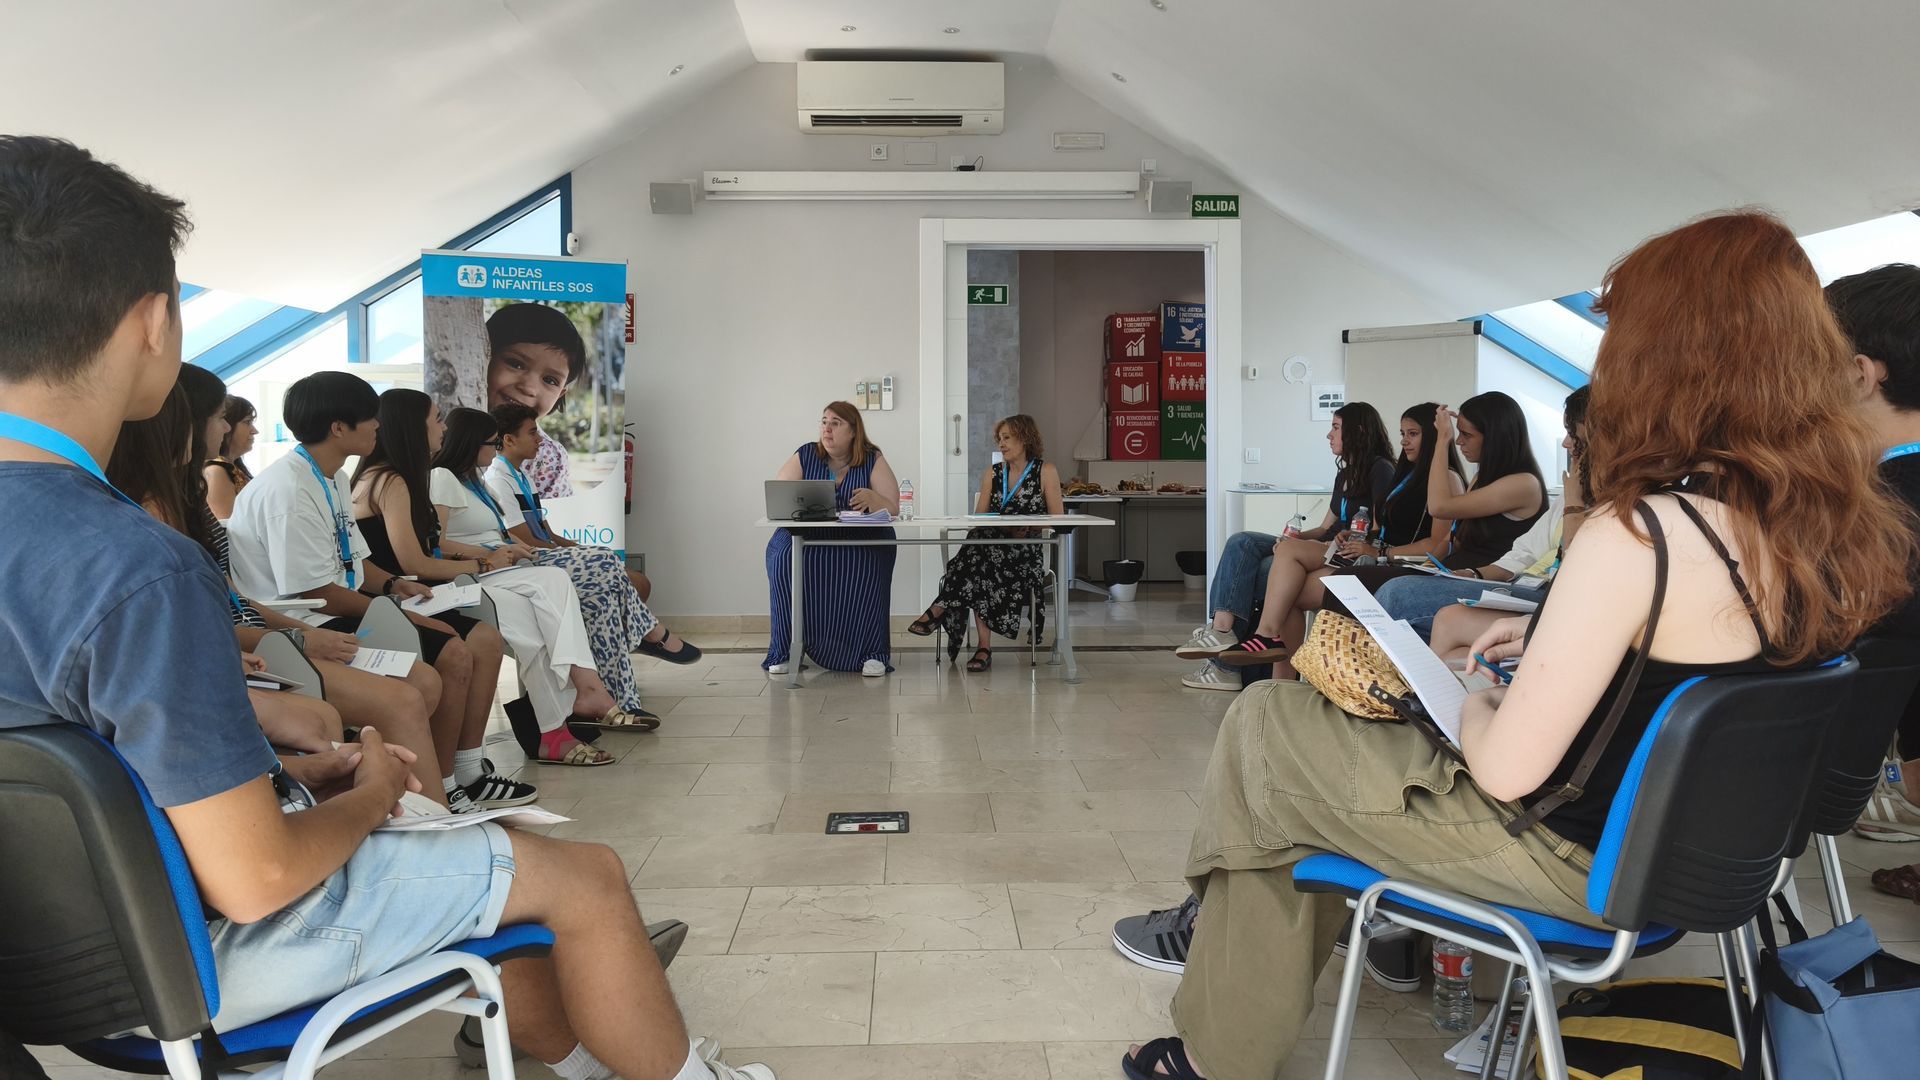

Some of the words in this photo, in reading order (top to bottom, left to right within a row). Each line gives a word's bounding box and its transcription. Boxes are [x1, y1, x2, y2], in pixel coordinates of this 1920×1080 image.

[1194, 200, 1237, 212] SALIDA
[492, 266, 542, 278] ALDEAS
[492, 279, 565, 292] INFANTILES
[568, 282, 594, 292] SOS
[1167, 306, 1176, 317] 16
[1116, 317, 1122, 328] 8
[1169, 356, 1172, 367] 1
[1115, 367, 1120, 377] 4
[1168, 406, 1174, 418] 3
[1115, 416, 1125, 426] 10
[564, 524, 614, 544] NIÑO
